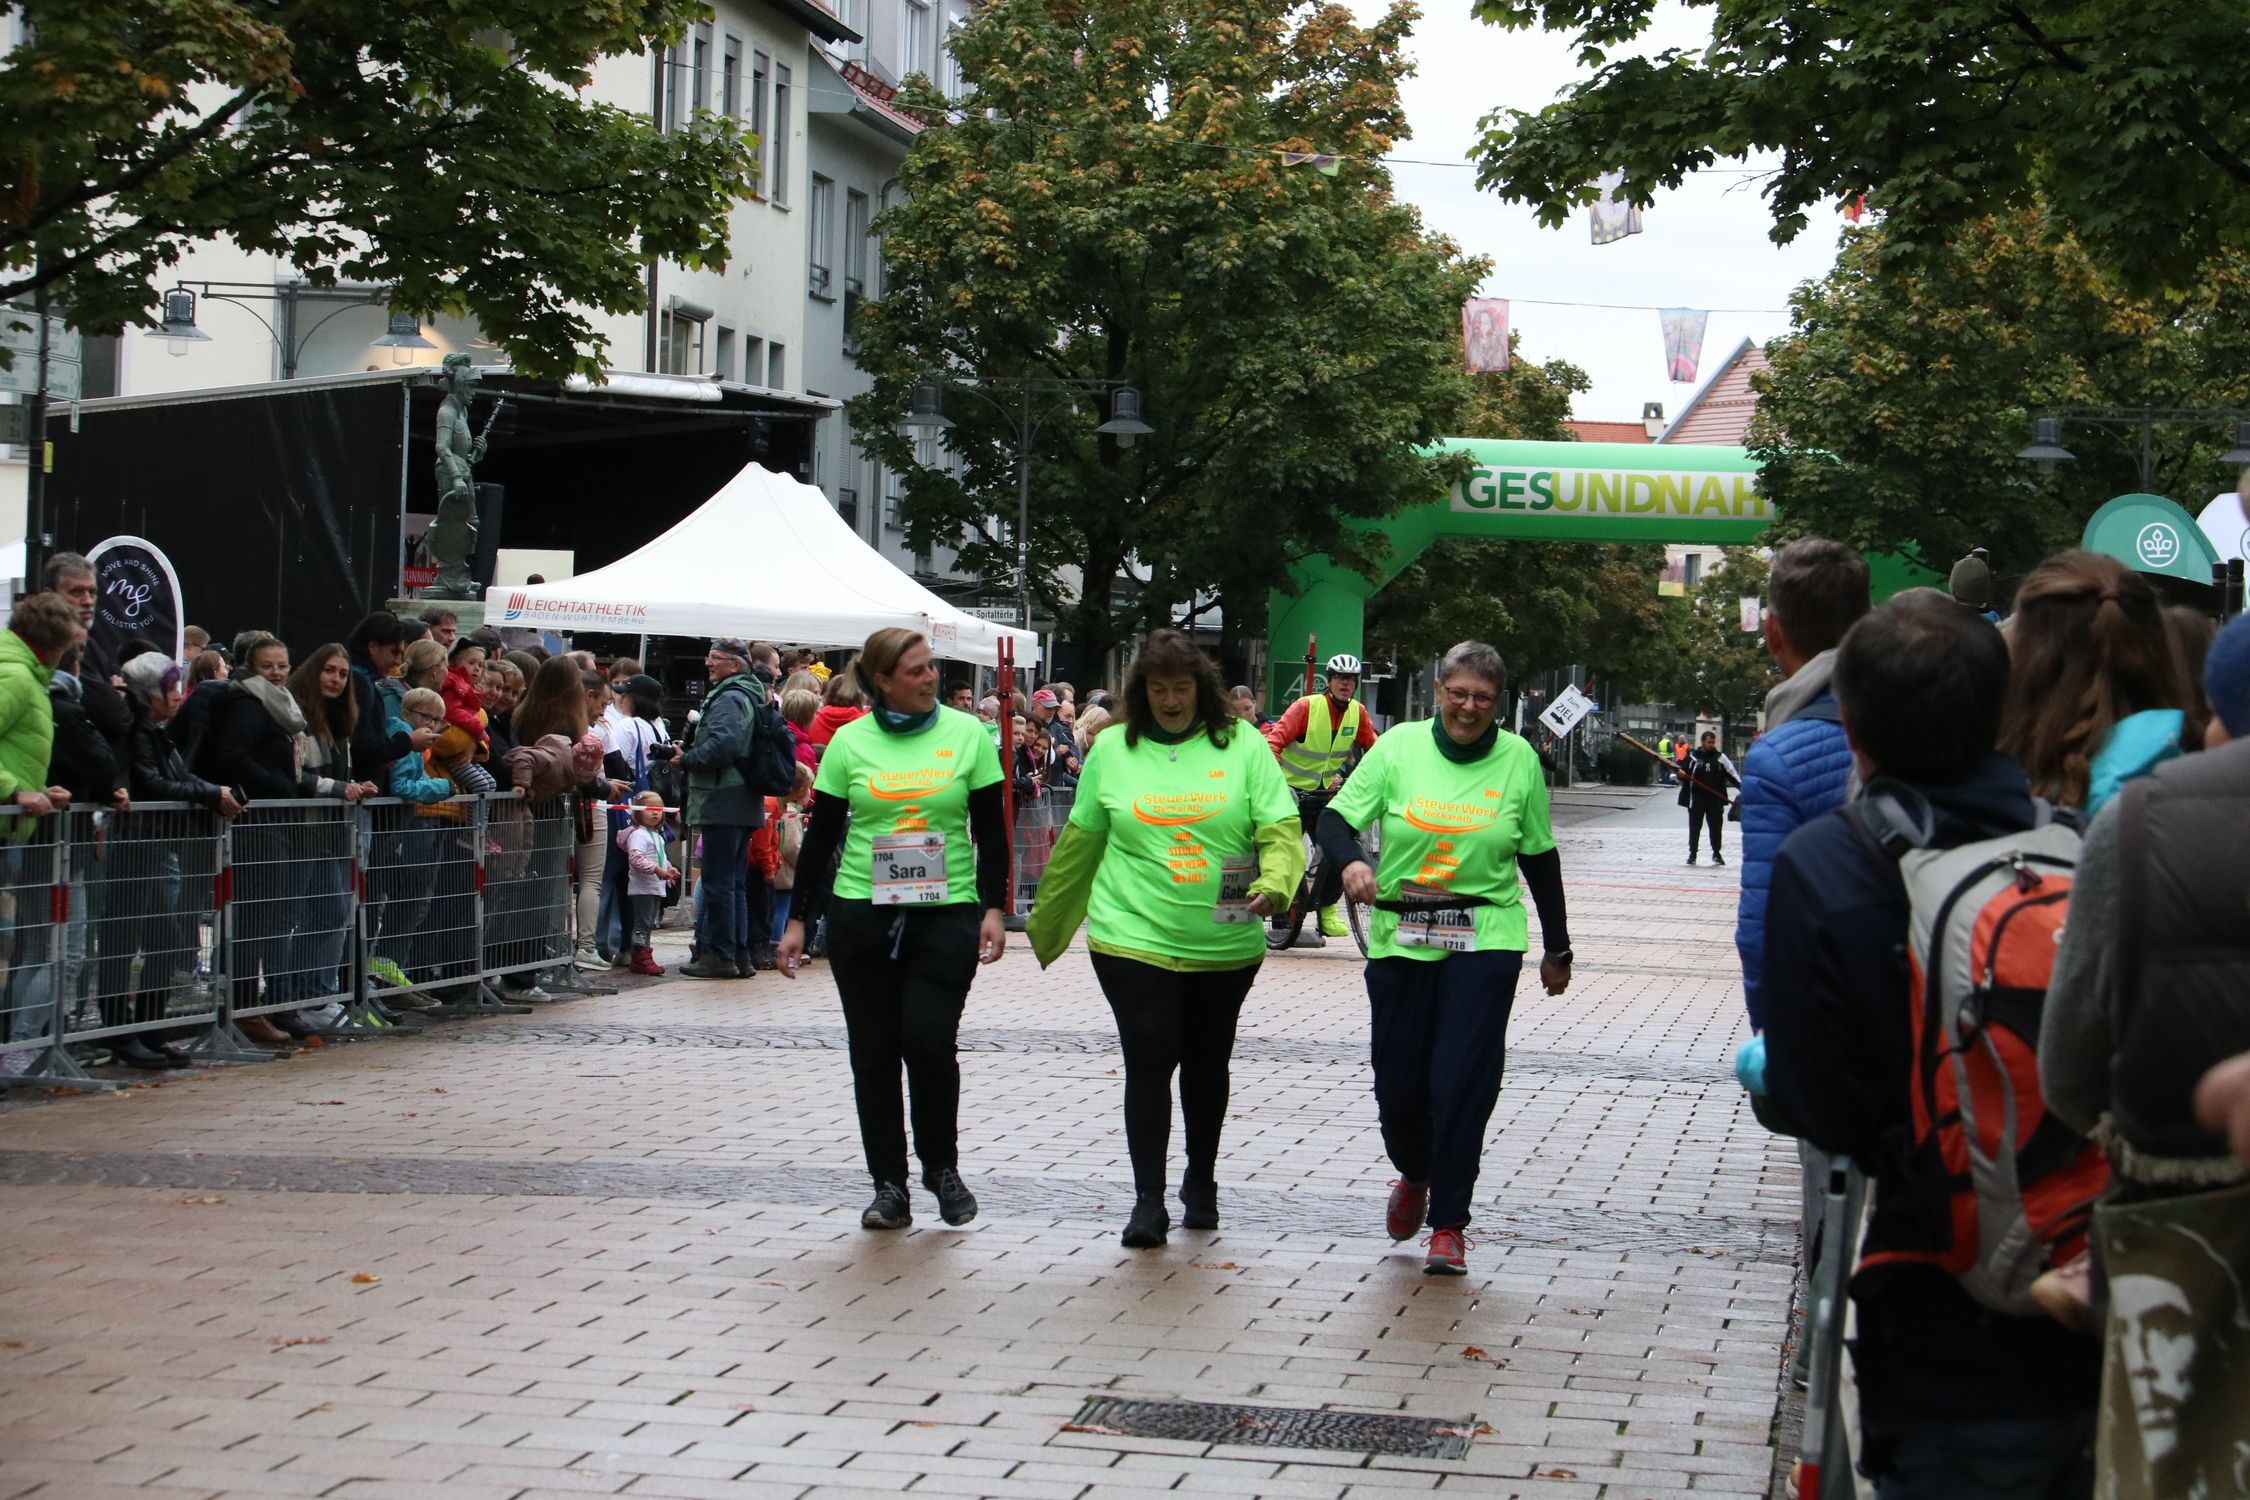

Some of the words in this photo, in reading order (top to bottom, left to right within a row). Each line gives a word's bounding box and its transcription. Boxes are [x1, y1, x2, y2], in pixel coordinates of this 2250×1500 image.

[1461, 469, 1765, 517] GESUNDNAH
[101, 560, 122, 578] MOVE
[124, 559, 139, 567] AND
[140, 563, 160, 586] SHINE
[404, 570, 436, 584] UNNING
[526, 599, 648, 616] LEICHTATHLETIK
[976, 609, 1014, 620] Spitaltörle
[101, 608, 138, 629] HOLISTIC
[139, 615, 154, 628] YOU
[1555, 703, 1574, 721] ZIEL
[878, 768, 954, 781] SteuerWerk
[1143, 791, 1227, 805] SteuerWerk
[1152, 804, 1203, 813] NeckarAlb
[1416, 797, 1497, 819] SteuerWerk
[1423, 809, 1472, 823] NeckarAlb
[873, 852, 895, 862] 1704
[889, 863, 927, 880] Sara
[919, 892, 940, 902] 1704
[1443, 940, 1467, 951] 1718
